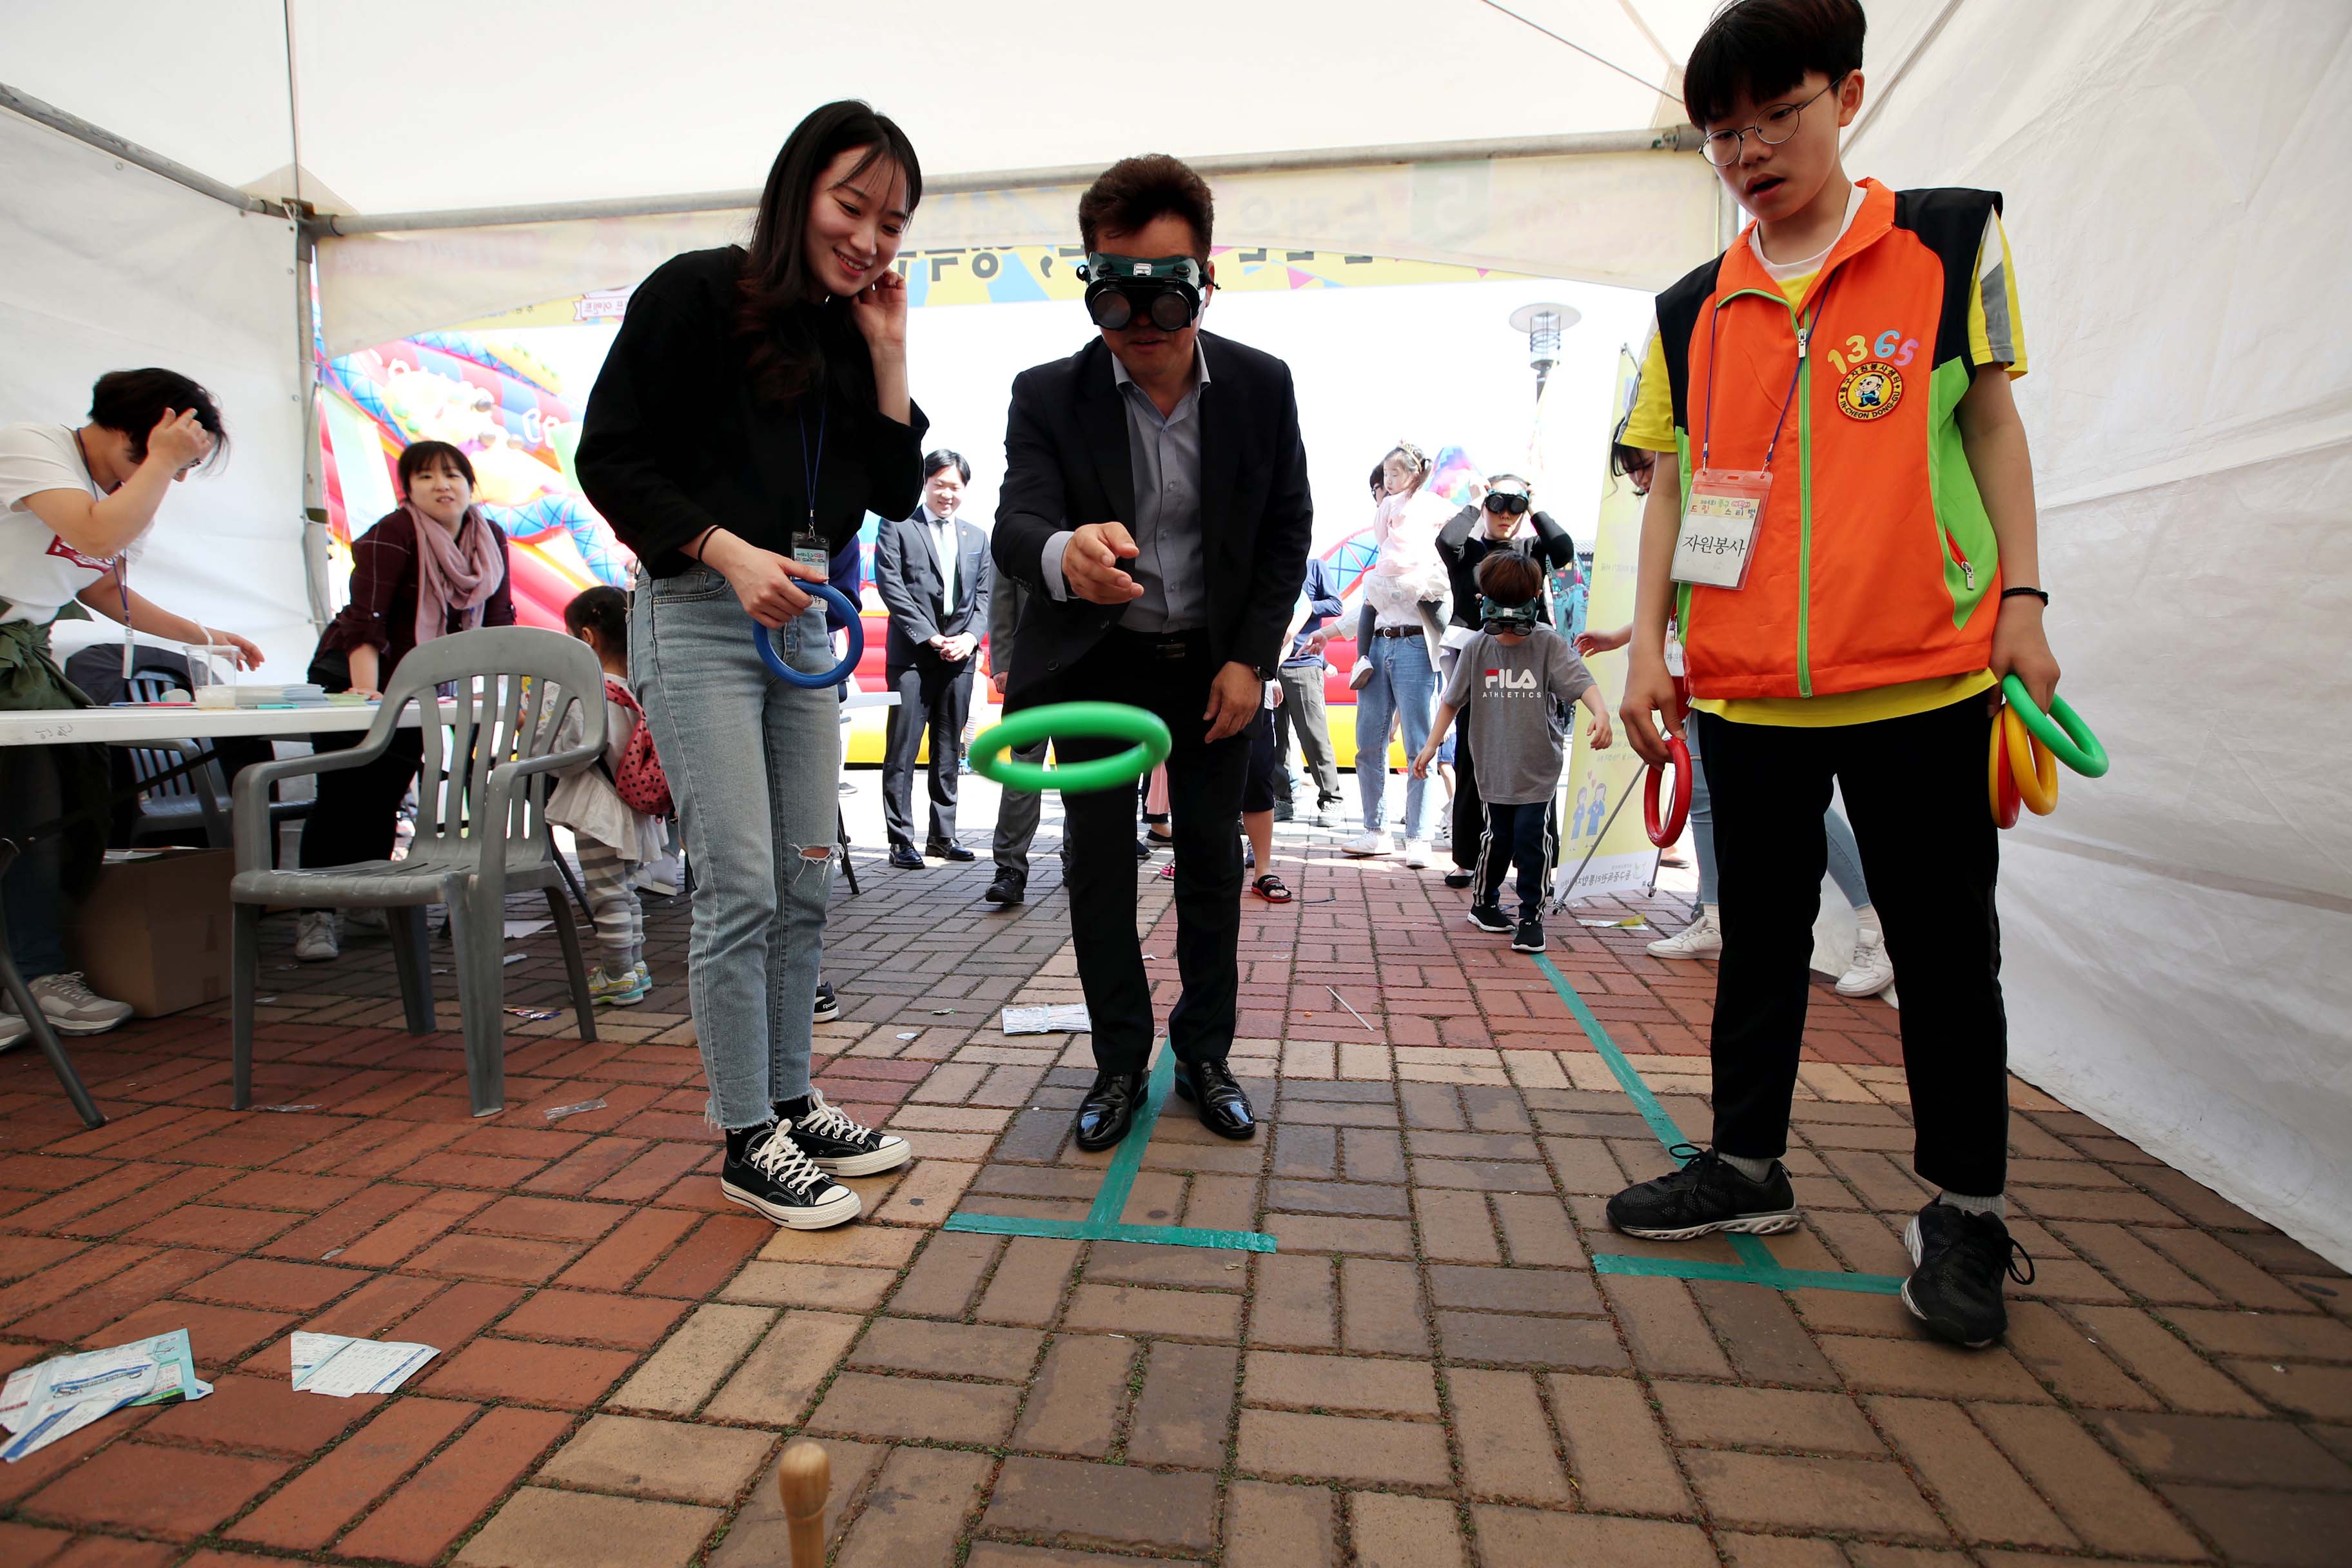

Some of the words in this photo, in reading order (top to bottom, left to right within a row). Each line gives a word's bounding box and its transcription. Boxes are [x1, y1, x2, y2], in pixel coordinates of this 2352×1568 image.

[1827, 330, 1919, 375] 1365
[1839, 363, 1901, 393] 동구자원봉사센터
[1840, 400, 1870, 418] IN-CHEON
[1872, 391, 1900, 418] DONG-GU
[1681, 534, 1746, 557] 자원봉사
[1485, 668, 1537, 689] FILA
